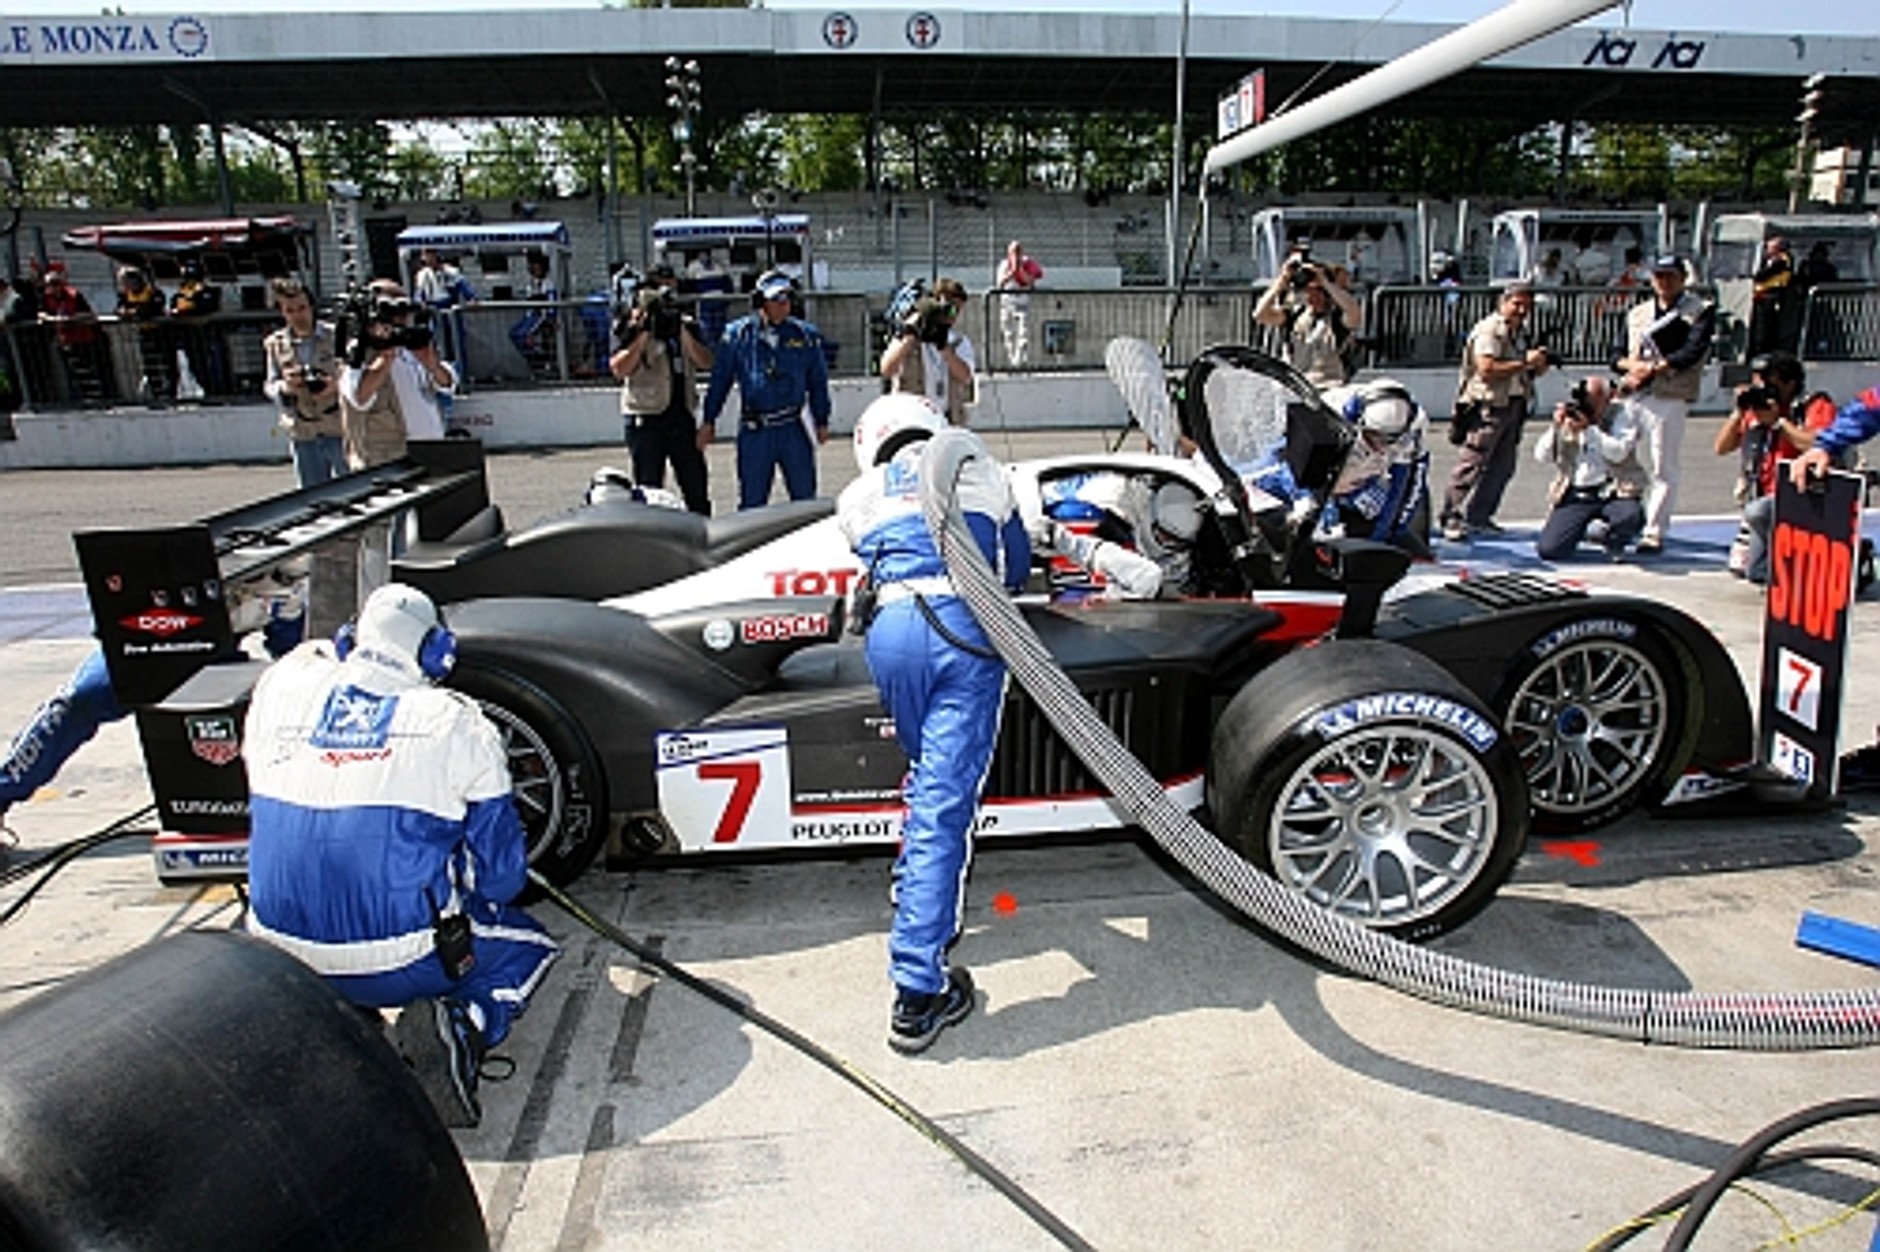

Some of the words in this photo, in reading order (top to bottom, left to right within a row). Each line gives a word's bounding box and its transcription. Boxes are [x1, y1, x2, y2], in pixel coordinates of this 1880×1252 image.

[41, 26, 159, 51] MONZA
[764, 568, 867, 597] TOT
[1771, 521, 1851, 641] STOP
[741, 613, 829, 643] BOSCH
[1788, 657, 1814, 713] 7
[1355, 694, 1495, 747] MICHELIN
[696, 761, 762, 843] 7
[792, 820, 893, 840] PEUGEOT
